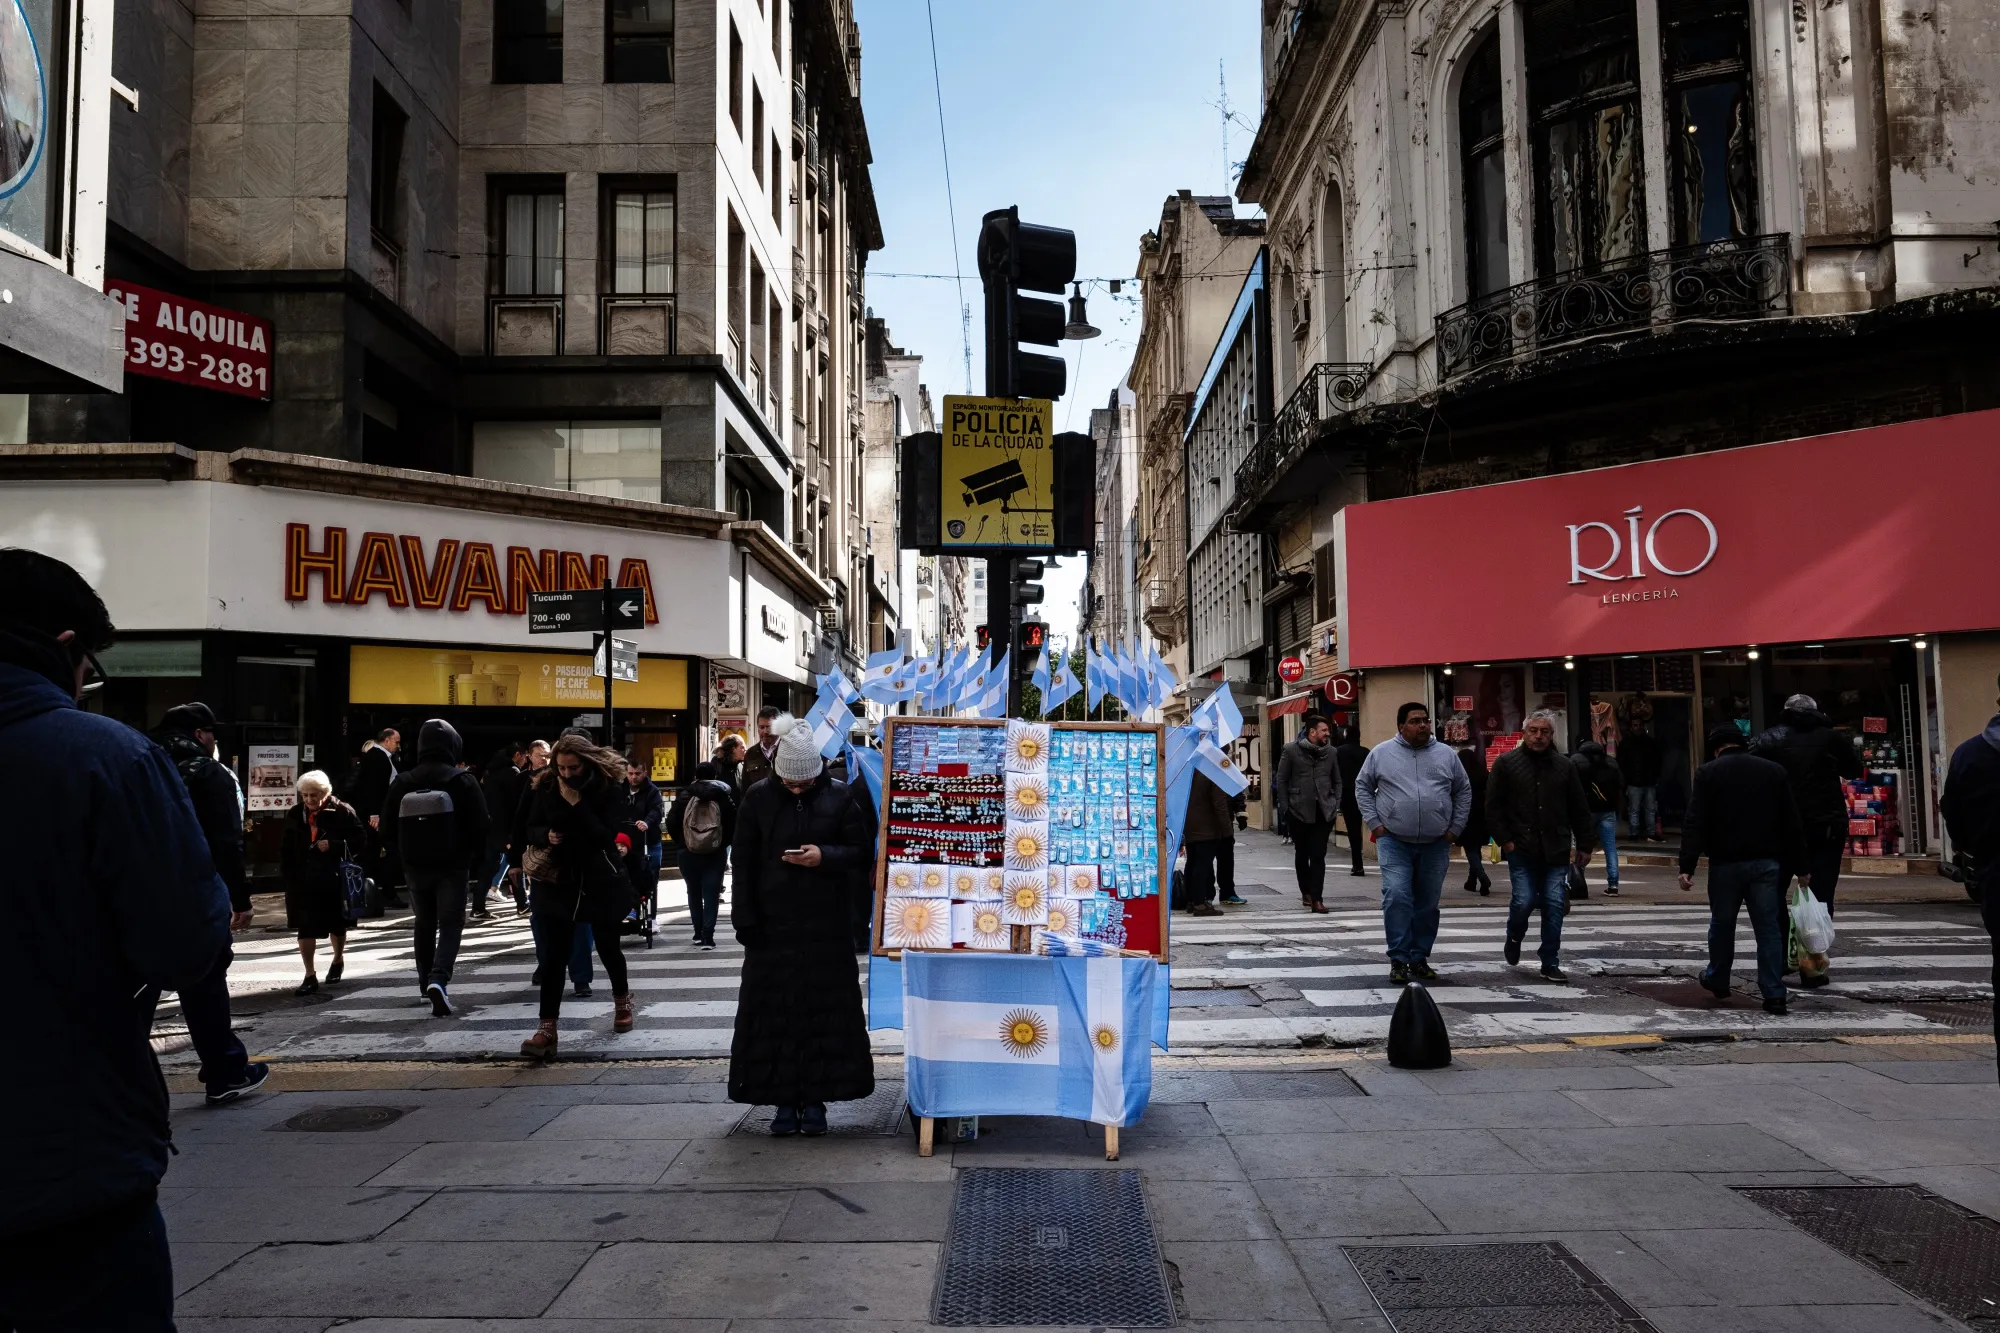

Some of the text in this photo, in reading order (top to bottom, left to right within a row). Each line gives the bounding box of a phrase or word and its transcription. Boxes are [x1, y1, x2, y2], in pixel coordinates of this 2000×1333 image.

[156, 301, 267, 353] ALQUILA
[124, 337, 267, 391] 393-2881
[979, 404, 1020, 412] MONITOREADO
[952, 411, 1043, 435] POLICIA
[952, 434, 1043, 449] DE LA CIUDAD
[1565, 505, 1719, 585] RÍO
[285, 522, 659, 624] HAVANNA
[532, 593, 573, 602] Tucumán
[1603, 587, 1679, 604] LENCERÍA
[532, 614, 548, 622] 700
[555, 613, 571, 621] 600
[555, 665, 594, 677] PASEADO
[555, 678, 567, 689] DE
[568, 676, 588, 689] CAFÉ
[1331, 679, 1352, 701] R
[555, 689, 605, 700] HAVANNA
[1245, 774, 1261, 786] FF
